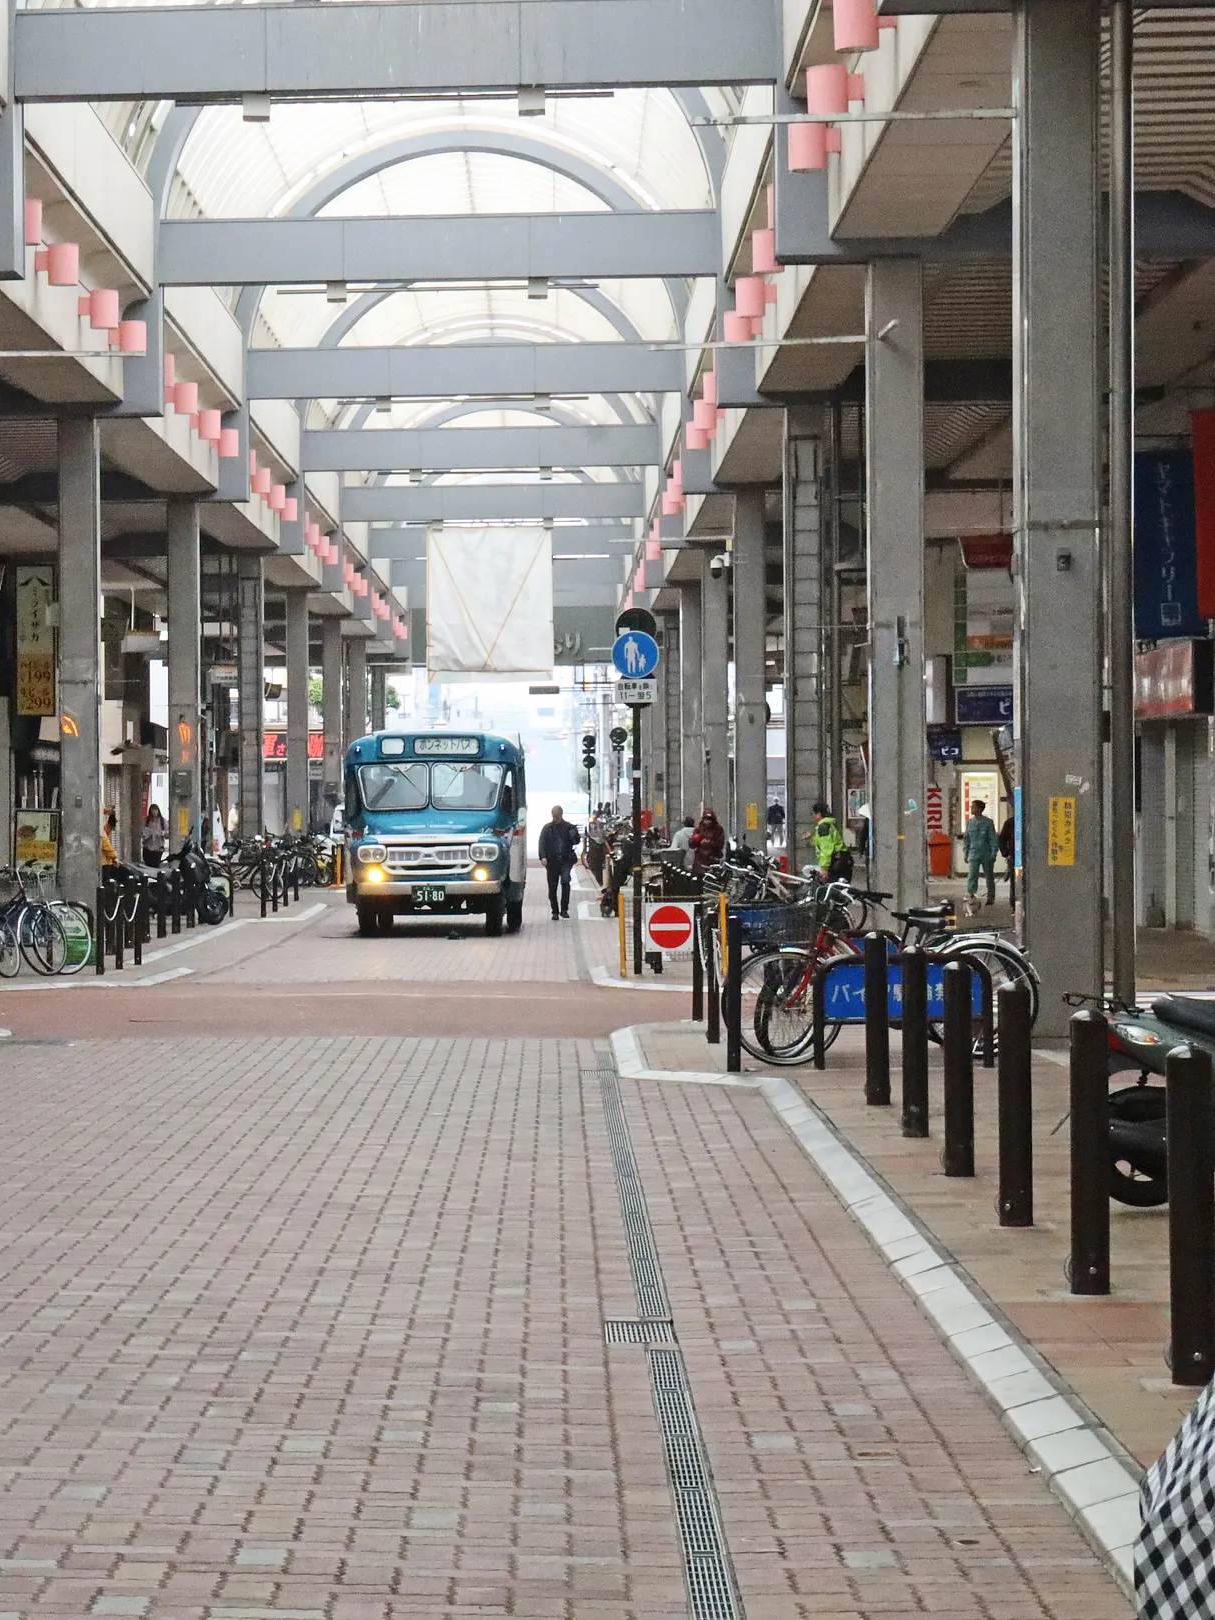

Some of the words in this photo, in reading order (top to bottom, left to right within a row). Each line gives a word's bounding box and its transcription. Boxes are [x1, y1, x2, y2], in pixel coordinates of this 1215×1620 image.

[419, 739, 472, 751] ボンネットバス
[927, 788, 943, 829] KIRI
